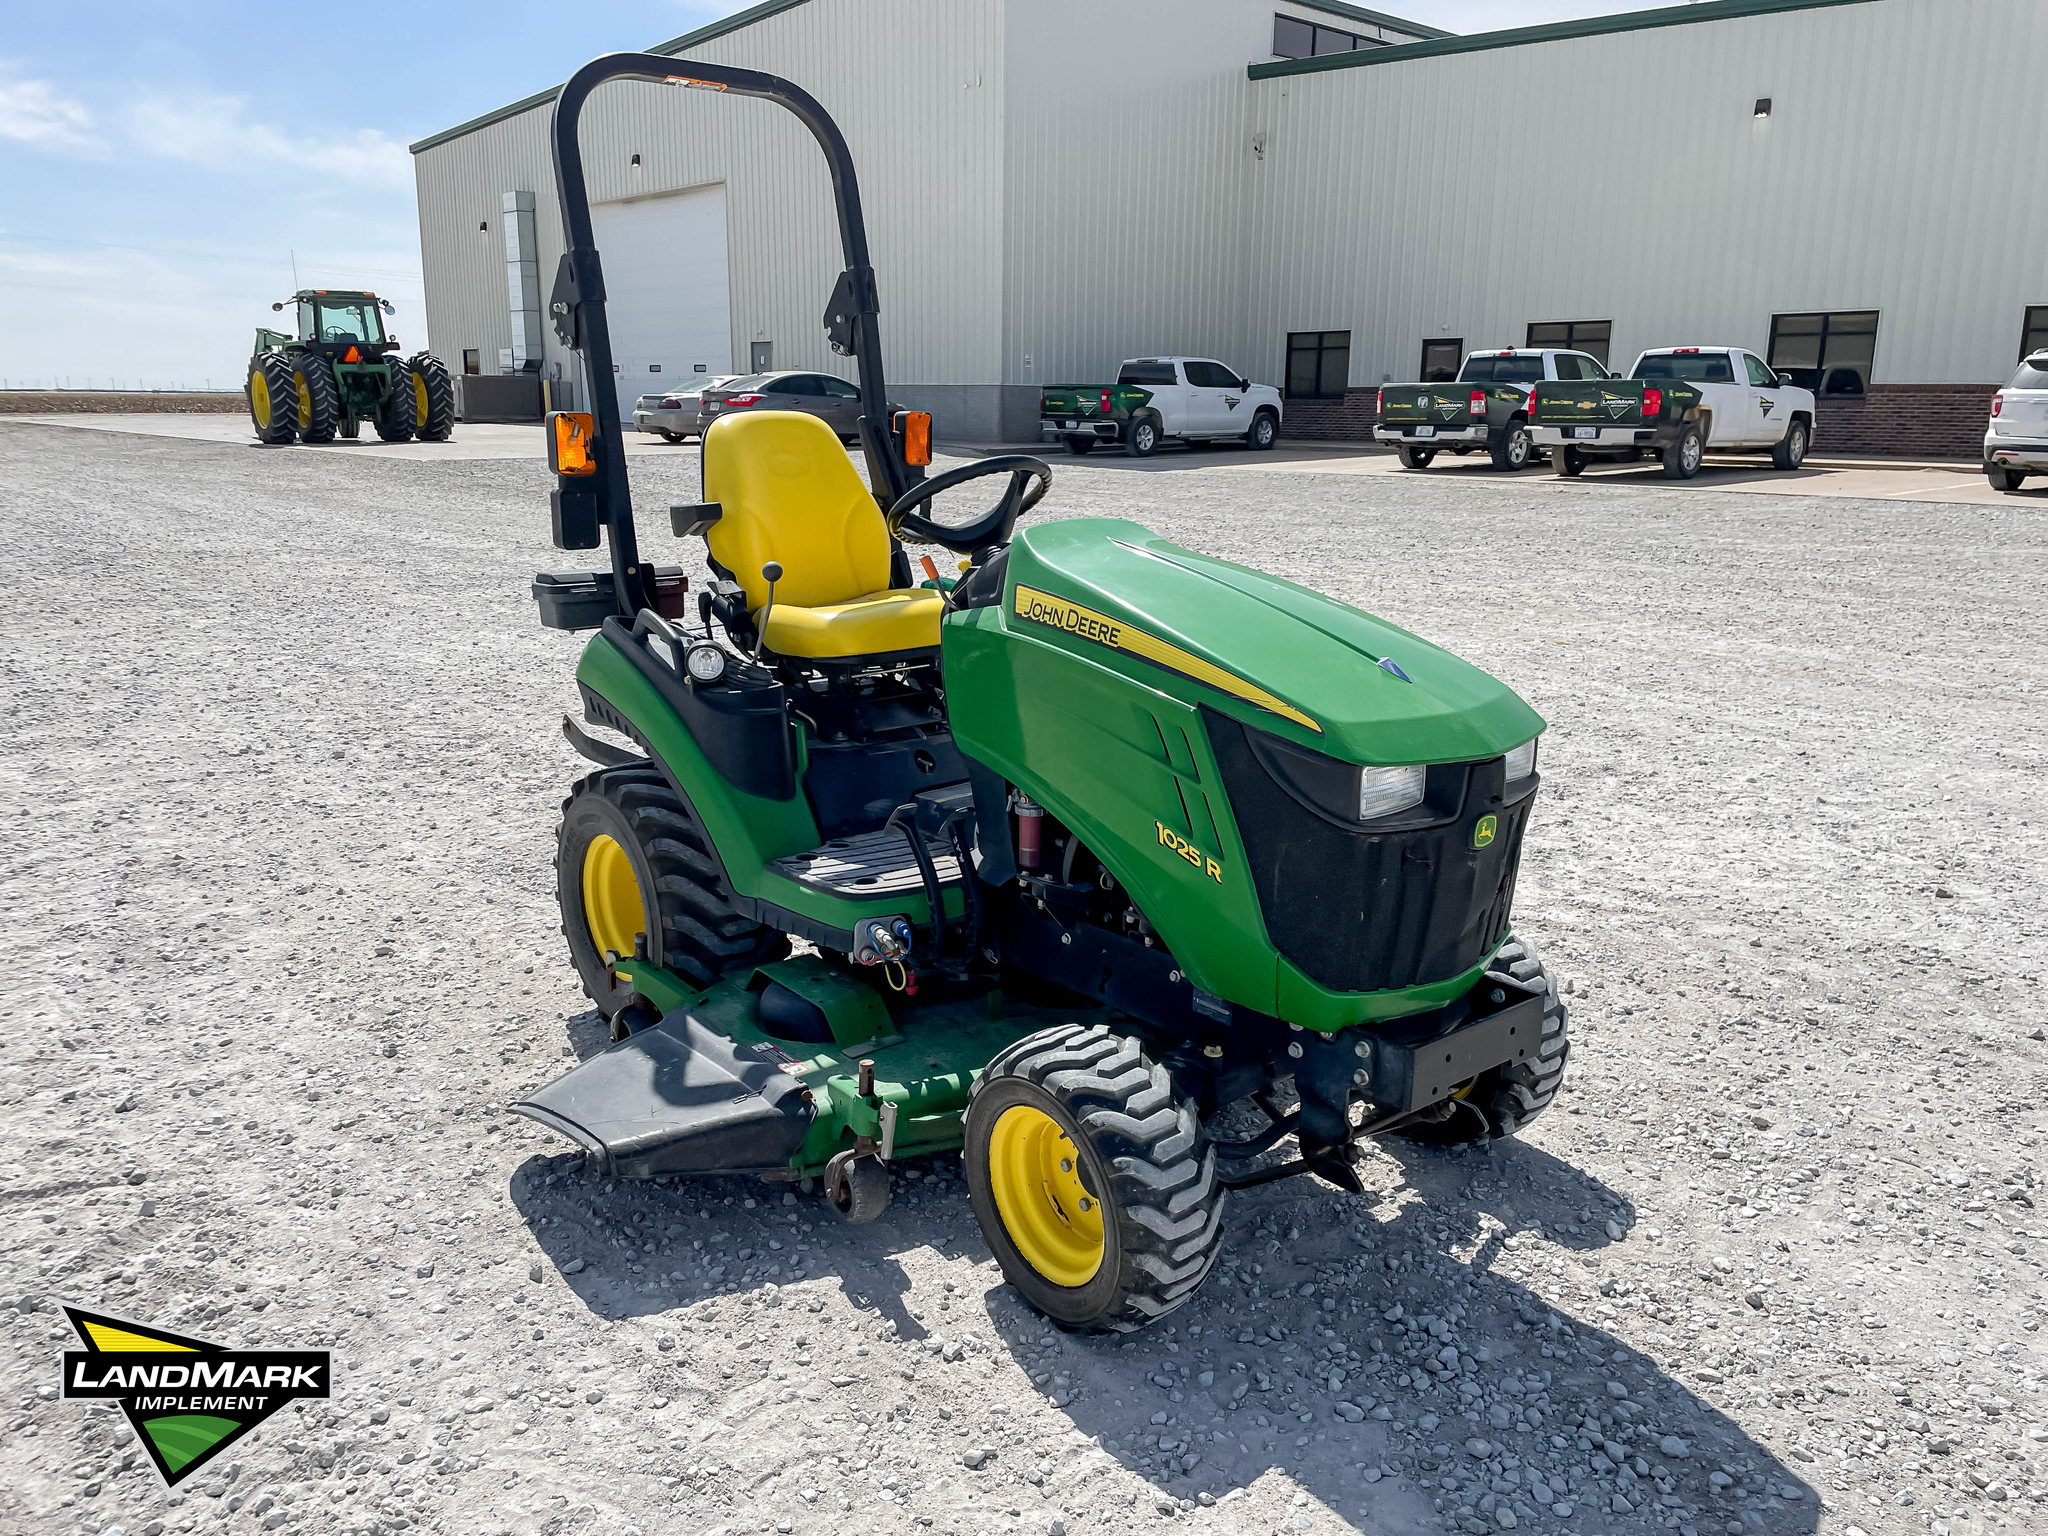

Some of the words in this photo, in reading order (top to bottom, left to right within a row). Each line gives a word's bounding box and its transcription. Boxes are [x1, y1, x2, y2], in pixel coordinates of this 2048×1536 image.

[1022, 598, 1064, 626] JOHN
[1065, 607, 1121, 645] DEERE
[1155, 820, 1202, 868] 1025
[1205, 855, 1223, 885] R
